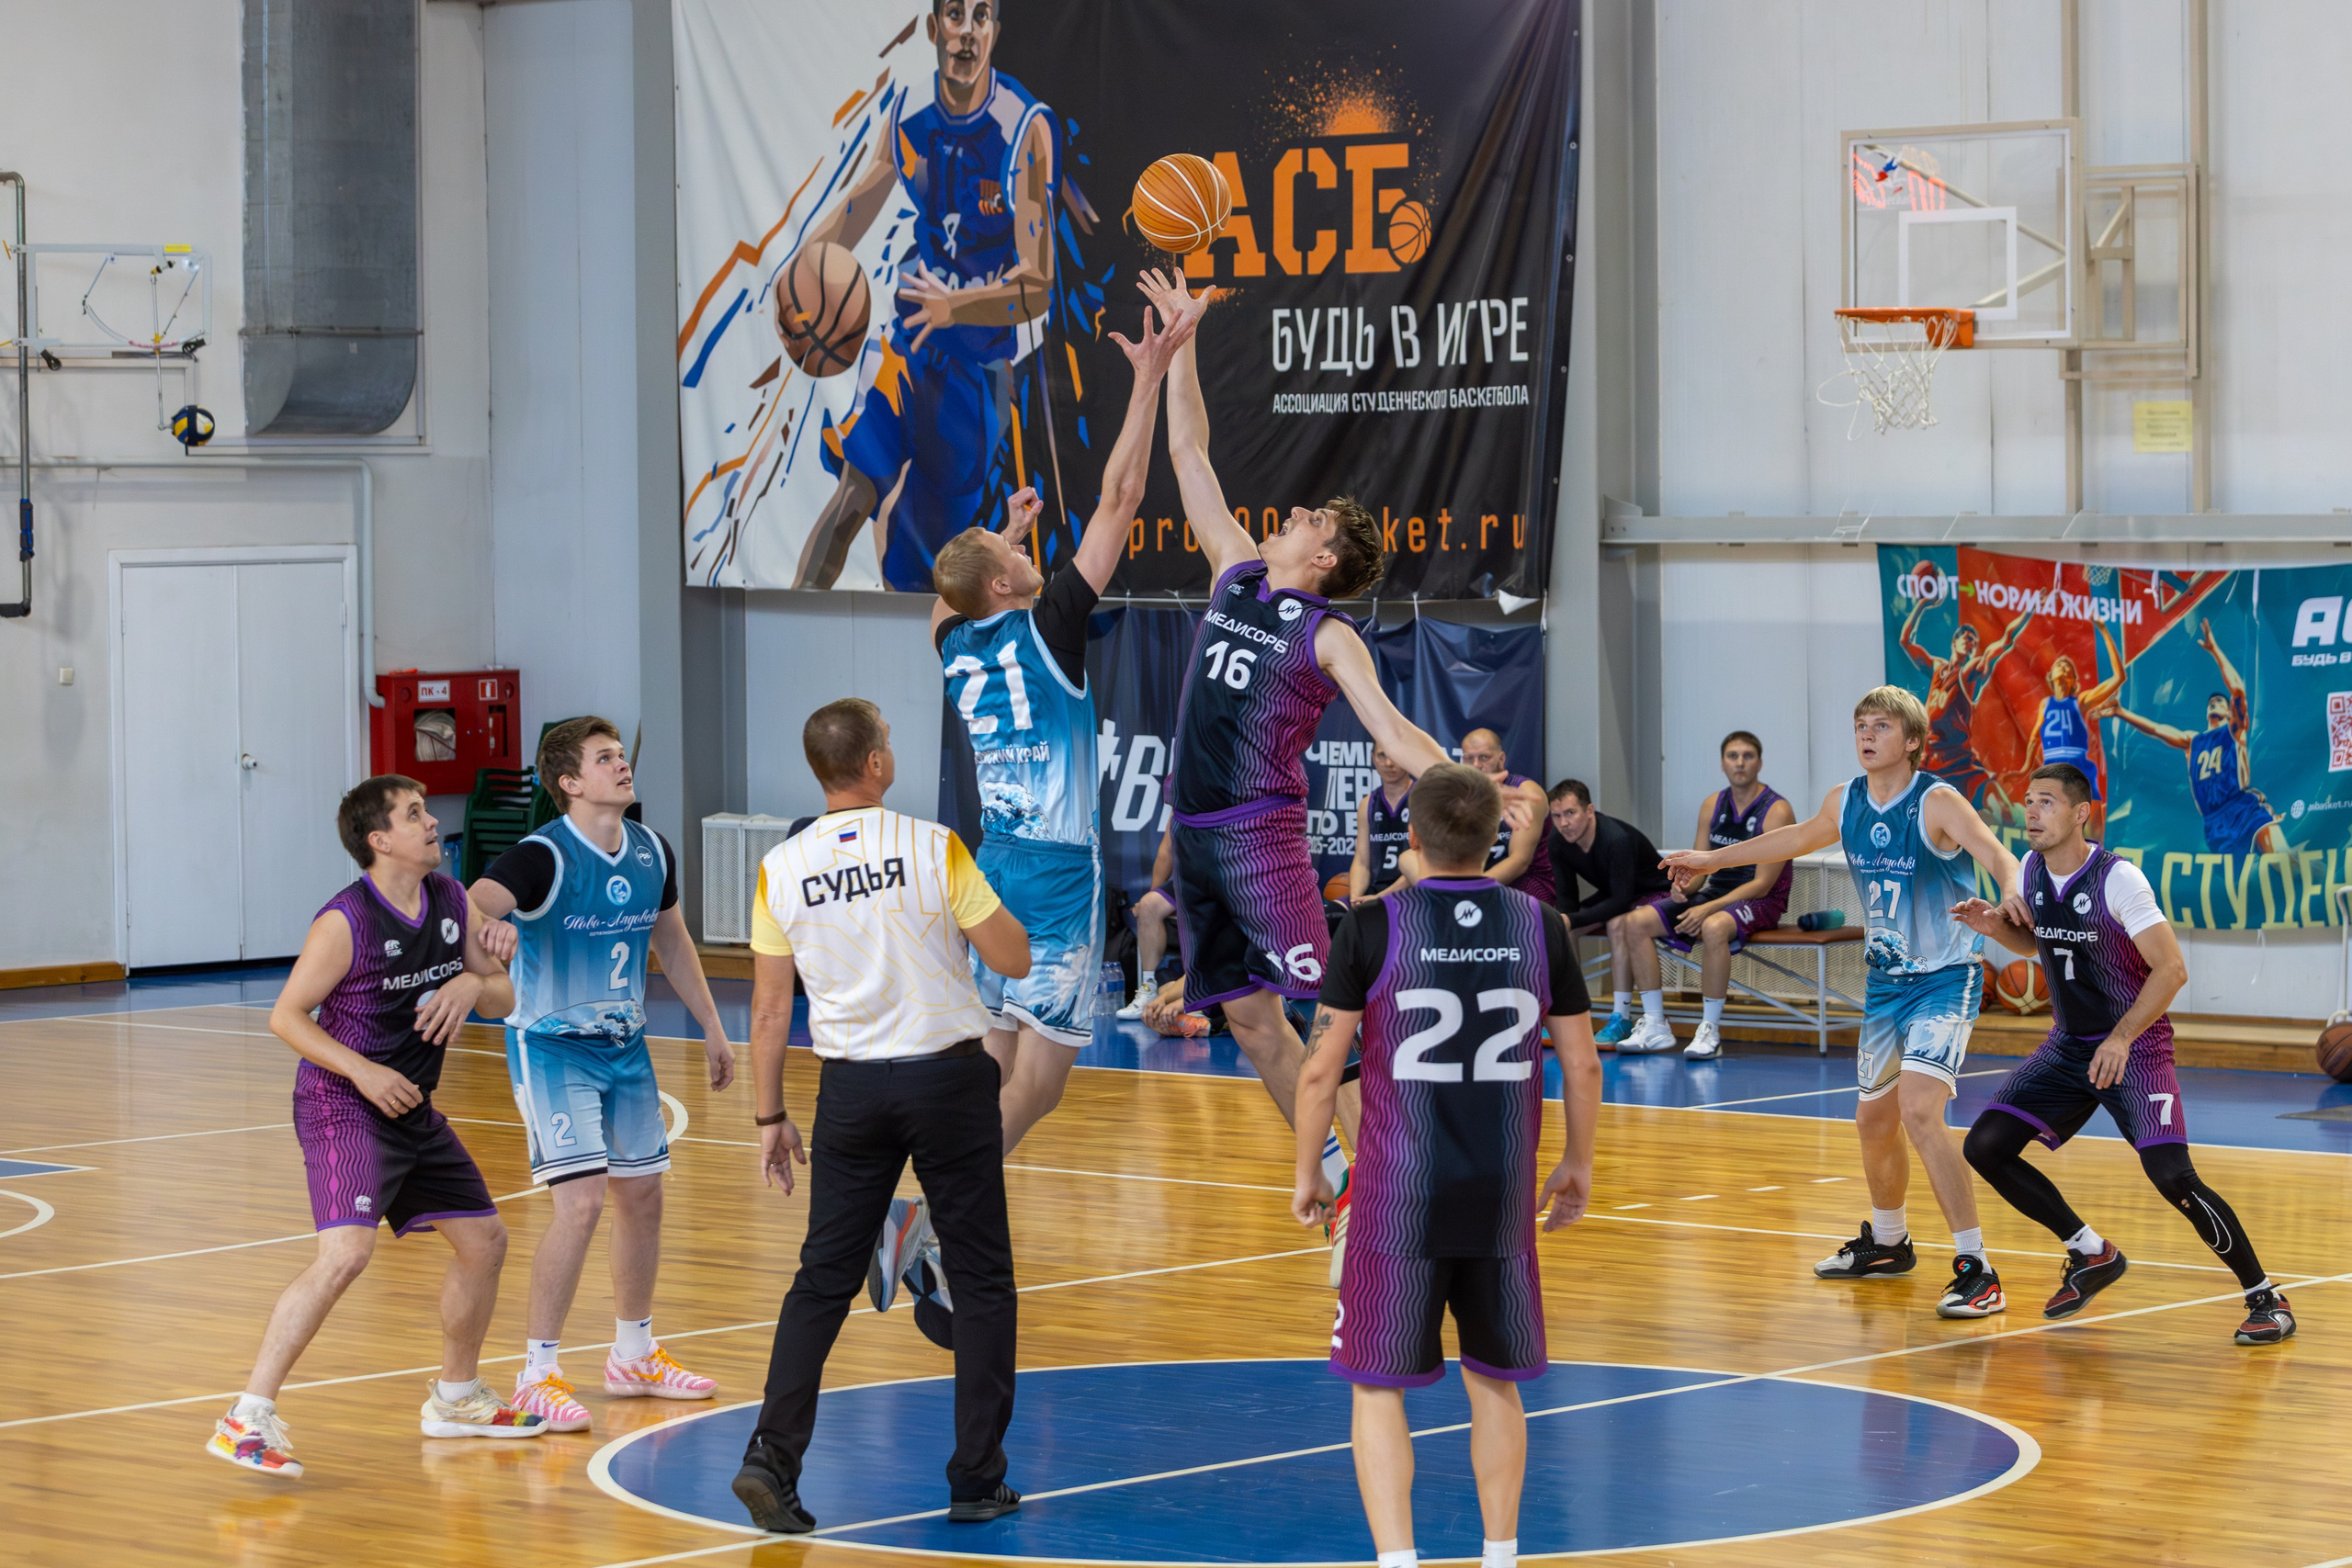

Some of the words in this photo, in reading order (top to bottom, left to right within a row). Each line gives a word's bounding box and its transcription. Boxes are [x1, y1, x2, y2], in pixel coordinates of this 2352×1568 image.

[1272, 307, 1375, 378] БУДЬ
[1391, 305, 1421, 368] В
[1437, 297, 1530, 367] ИГРЕ
[1272, 392, 1350, 415] АССОЦИАЦИЯ
[1450, 384, 1530, 409] БАСКЕТБОЛА
[1896, 573, 1959, 600] СПОРТ
[1974, 580, 2056, 617] НОРМА
[2057, 590, 2143, 626] ЖИЗНИ
[1204, 608, 1289, 654] МЕДИСОРБ
[1205, 640, 1258, 690] 16
[2291, 653, 2338, 667] БУДЬ
[944, 639, 1033, 735] 21
[1930, 688, 1949, 710] 20
[2044, 709, 2074, 738] 24
[1016, 740, 1051, 764] КРАЙ
[2197, 745, 2223, 781] 24
[1383, 845, 1408, 870] 5
[802, 857, 906, 908] СУДЬЯ
[1868, 879, 1902, 919] 27
[608, 941, 630, 990] 2
[1420, 947, 1521, 963] МЕДИСОРБ
[2052, 947, 2076, 981] 7
[1391, 987, 1541, 1083] 22
[2148, 1093, 2174, 1126] 7
[550, 1111, 576, 1149] 2
